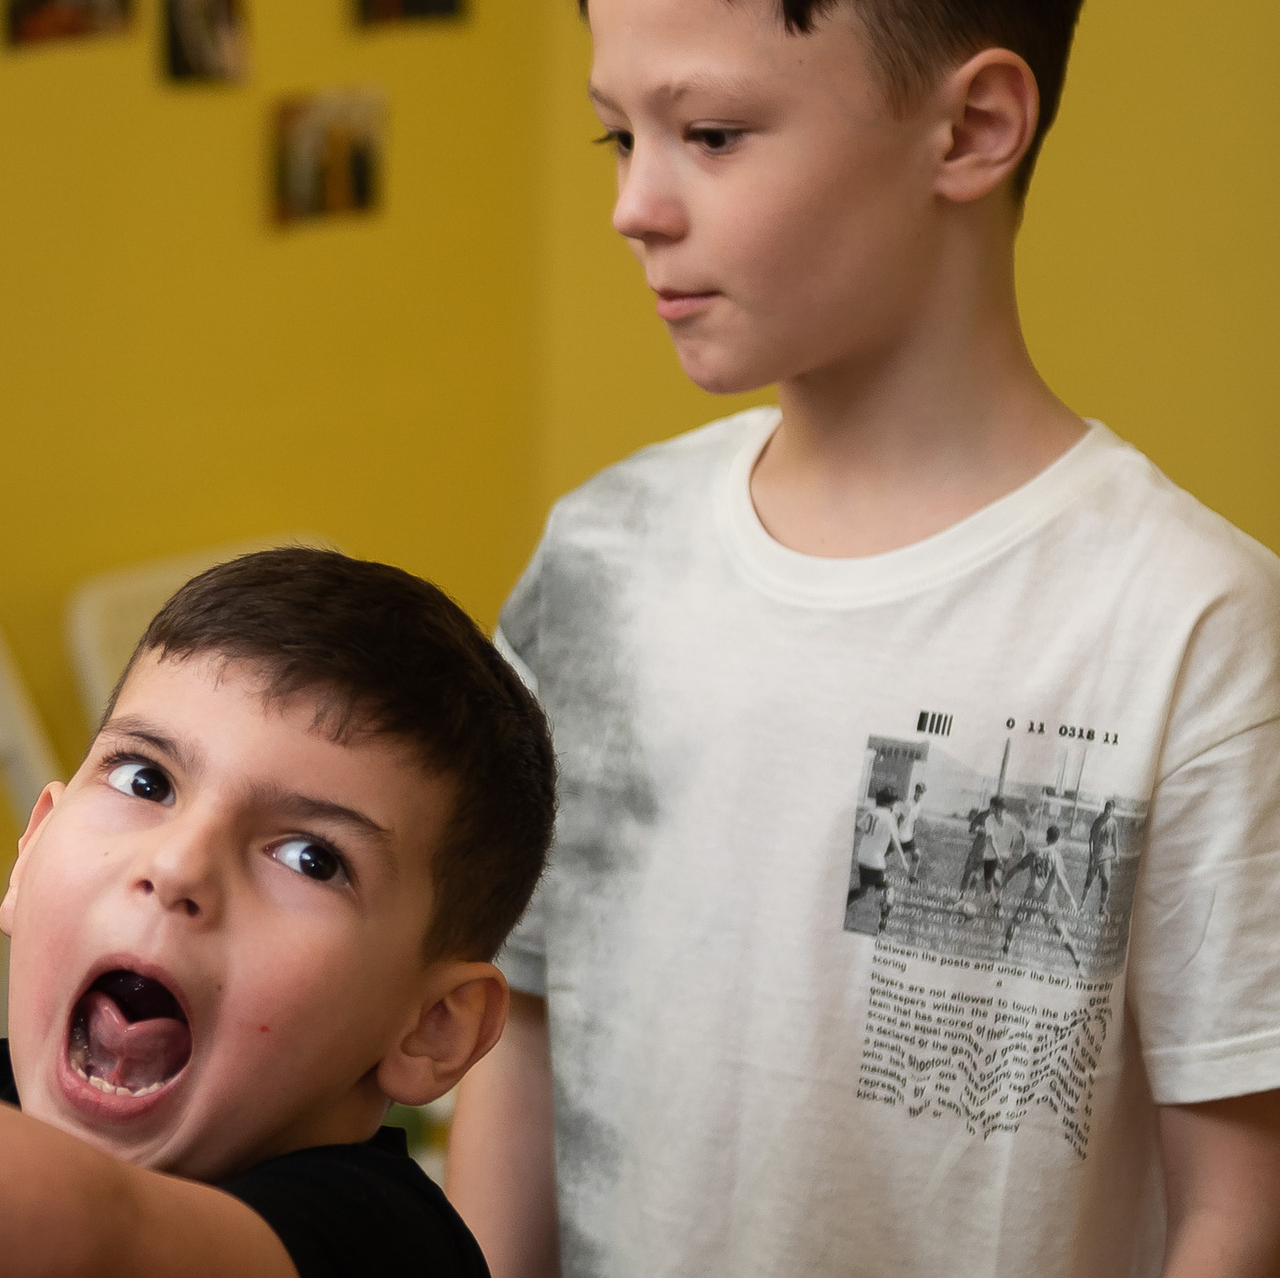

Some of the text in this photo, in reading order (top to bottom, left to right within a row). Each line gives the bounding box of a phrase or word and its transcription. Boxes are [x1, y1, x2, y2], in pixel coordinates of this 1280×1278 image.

[1027, 720, 1046, 735] 11
[1058, 725, 1096, 742] 0318
[1102, 731, 1120, 746] 11
[871, 954, 908, 973] scoring
[873, 939, 919, 960] (between
[921, 951, 937, 963] the
[940, 956, 971, 971] posts
[973, 961, 995, 973] and
[997, 965, 1026, 979] under
[1029, 969, 1045, 983] the
[869, 986, 927, 1009] goalkeepers
[933, 1002, 964, 1017] within
[970, 1006, 988, 1019] the
[994, 1011, 1031, 1029] penalty
[870, 970, 904, 991] Players
[908, 984, 926, 995] are
[929, 988, 947, 999] not
[951, 991, 993, 1007] allowed
[998, 997, 1009, 1010] to
[1012, 1000, 1038, 1016] touch
[1042, 1006, 1059, 1020] the
[867, 1009, 898, 1026] scored
[914, 1023, 942, 1037] equal
[915, 1009, 933, 1023] has
[936, 1016, 974, 1031] scored
[873, 1039, 906, 1060] penalty
[876, 1026, 917, 1046] declared
[931, 1040, 949, 1053] the
[862, 1049, 884, 1063] who
